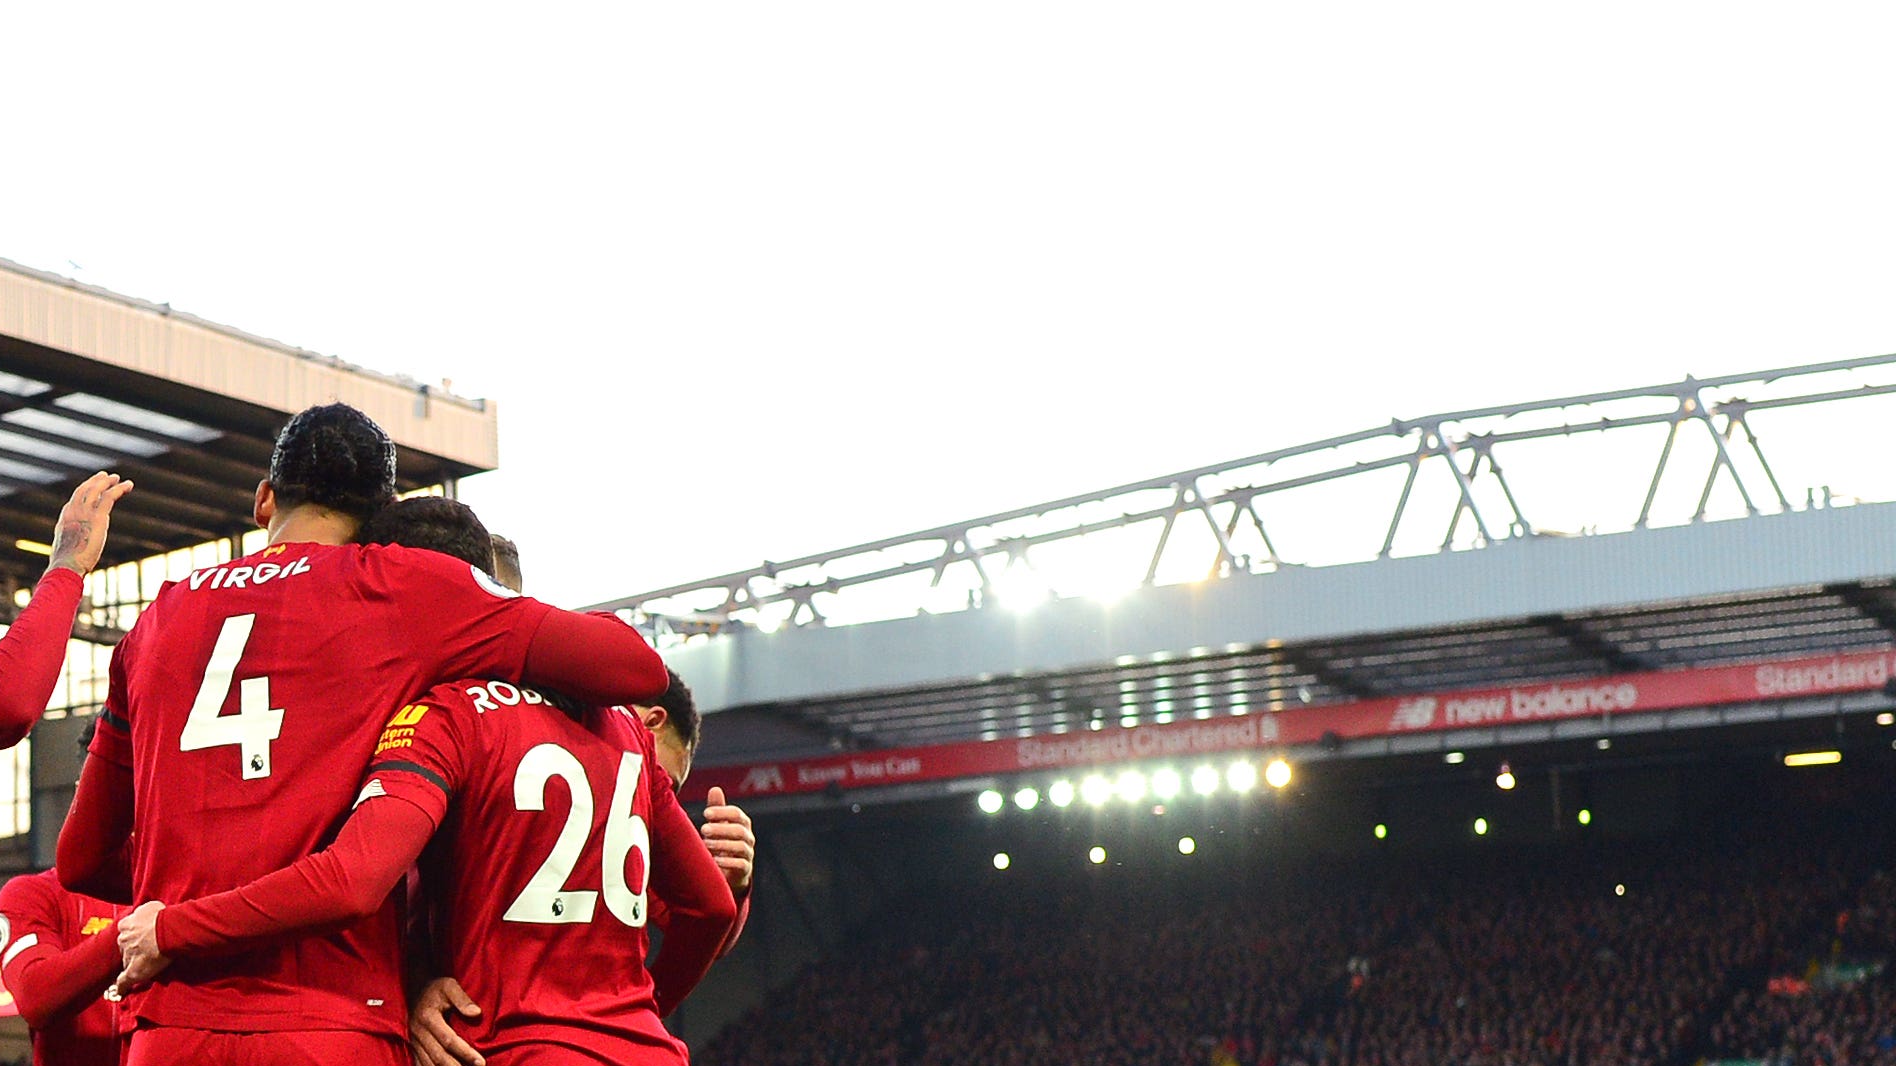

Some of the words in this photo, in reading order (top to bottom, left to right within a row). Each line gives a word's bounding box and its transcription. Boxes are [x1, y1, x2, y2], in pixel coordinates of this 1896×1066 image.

[189, 556, 311, 591] VIRGIL
[179, 613, 285, 781] 4
[1445, 692, 1507, 724] new
[1509, 682, 1639, 717] balance
[1755, 655, 1888, 696] Standard
[1016, 732, 1130, 768] Standard
[1131, 719, 1256, 752] Chartered
[504, 742, 652, 928] 26
